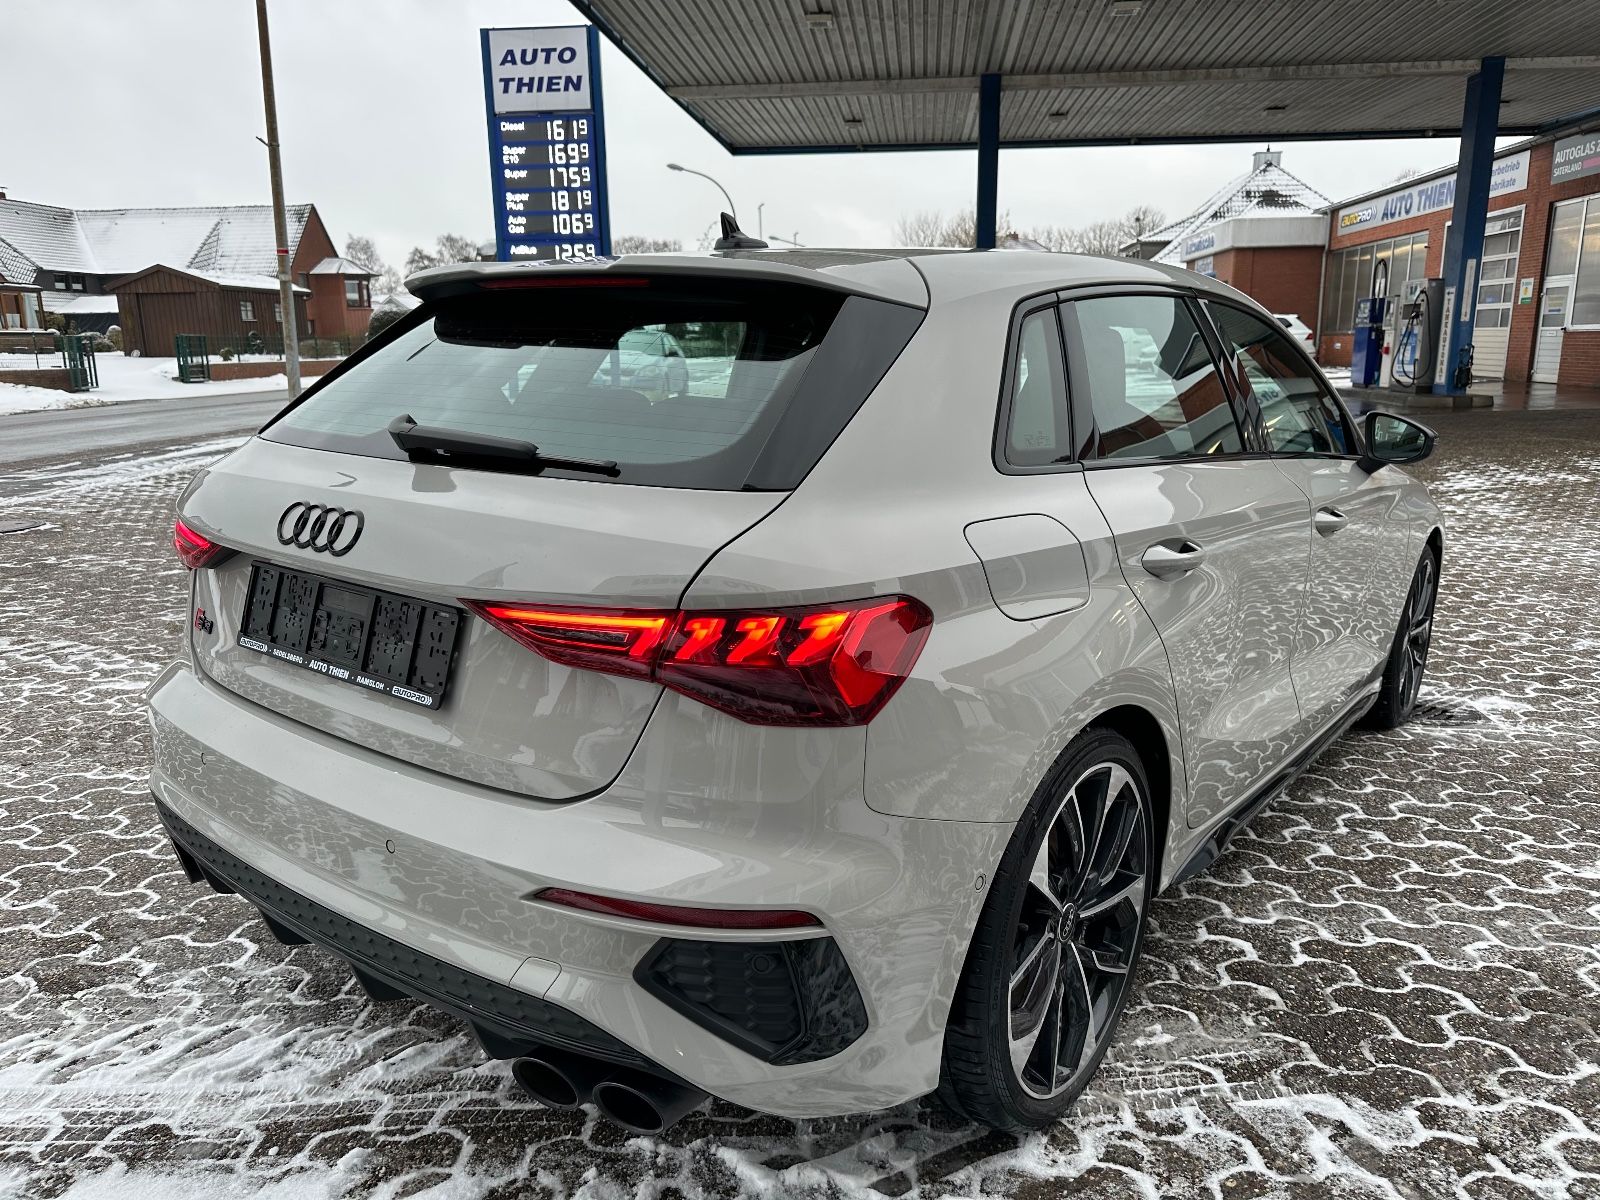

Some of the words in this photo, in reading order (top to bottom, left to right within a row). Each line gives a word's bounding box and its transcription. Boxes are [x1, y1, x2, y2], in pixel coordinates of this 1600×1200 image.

[499, 46, 577, 66] AUTO
[498, 75, 583, 94] THIEN
[500, 121, 525, 131] Diesel
[546, 119, 588, 140] 1619
[502, 145, 526, 155] Super
[548, 143, 589, 165] 1699
[502, 155, 519, 164] E10
[1554, 141, 1596, 164] AUTOGLAS
[504, 168, 528, 179] Super
[549, 166, 591, 188] 1759
[1553, 162, 1582, 177] SATERLAND
[505, 191, 530, 202] Super
[551, 190, 592, 211] 1819
[506, 201, 524, 211] Plus
[1381, 192, 1414, 221] AUTO
[1416, 180, 1456, 212] THIEN
[507, 215, 527, 225] Auto
[552, 213, 594, 234] 1069
[508, 224, 525, 234] Gas
[309, 660, 328, 673] AUTO
[328, 665, 350, 680] THIEN
[356, 675, 385, 690] RAMSLOH
